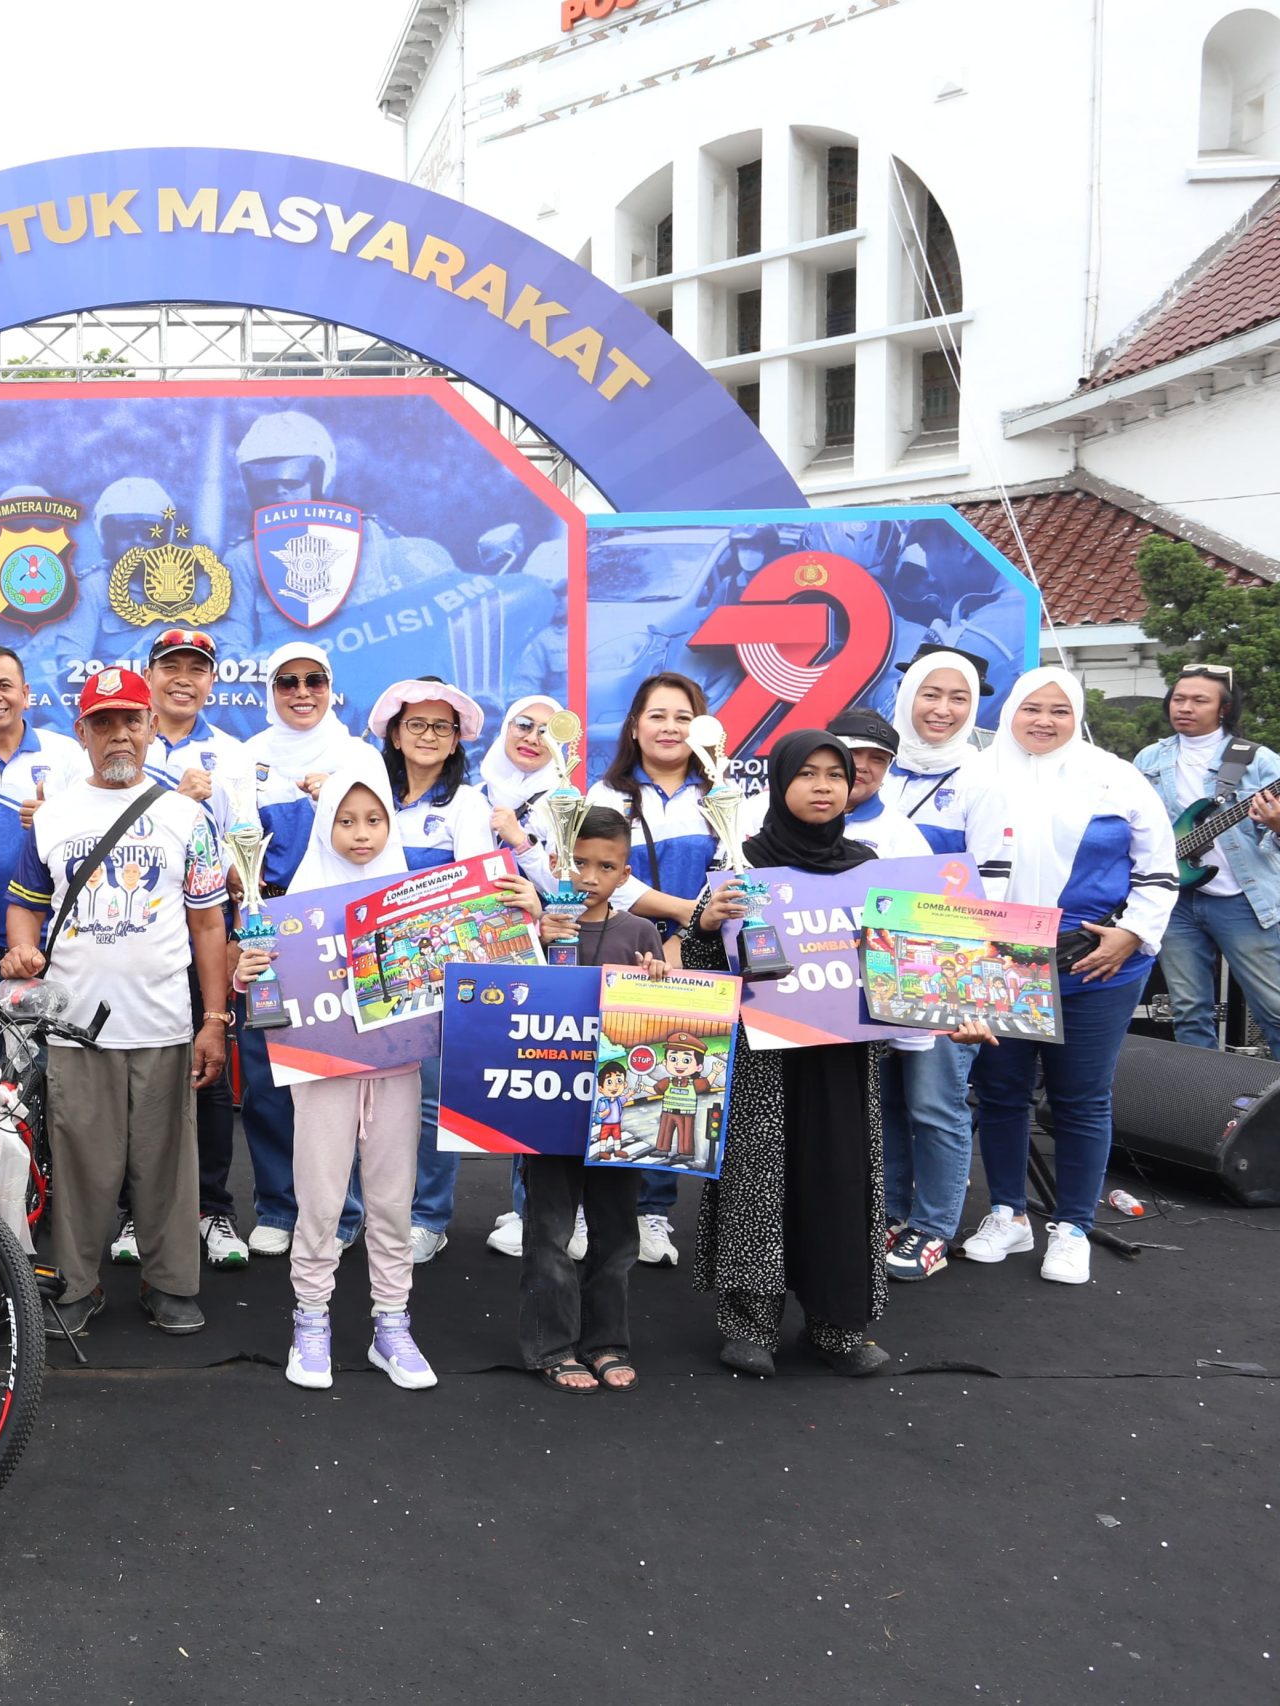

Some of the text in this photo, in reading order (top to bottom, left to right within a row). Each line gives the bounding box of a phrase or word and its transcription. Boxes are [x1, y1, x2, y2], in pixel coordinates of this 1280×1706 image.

[158, 187, 651, 403] MASYARAKAT
[44, 503, 78, 520] UTARA
[264, 507, 353, 524] LALU LINTAS
[434, 575, 495, 613] BM
[387, 870, 463, 902] LOMBA MEWARNAI
[917, 902, 1007, 918] LOMBA MEWARNAI
[96, 933, 116, 944] 2024
[799, 939, 848, 953] LOMBA
[517, 1047, 569, 1061] LOMBA
[631, 1055, 652, 1064] STOP
